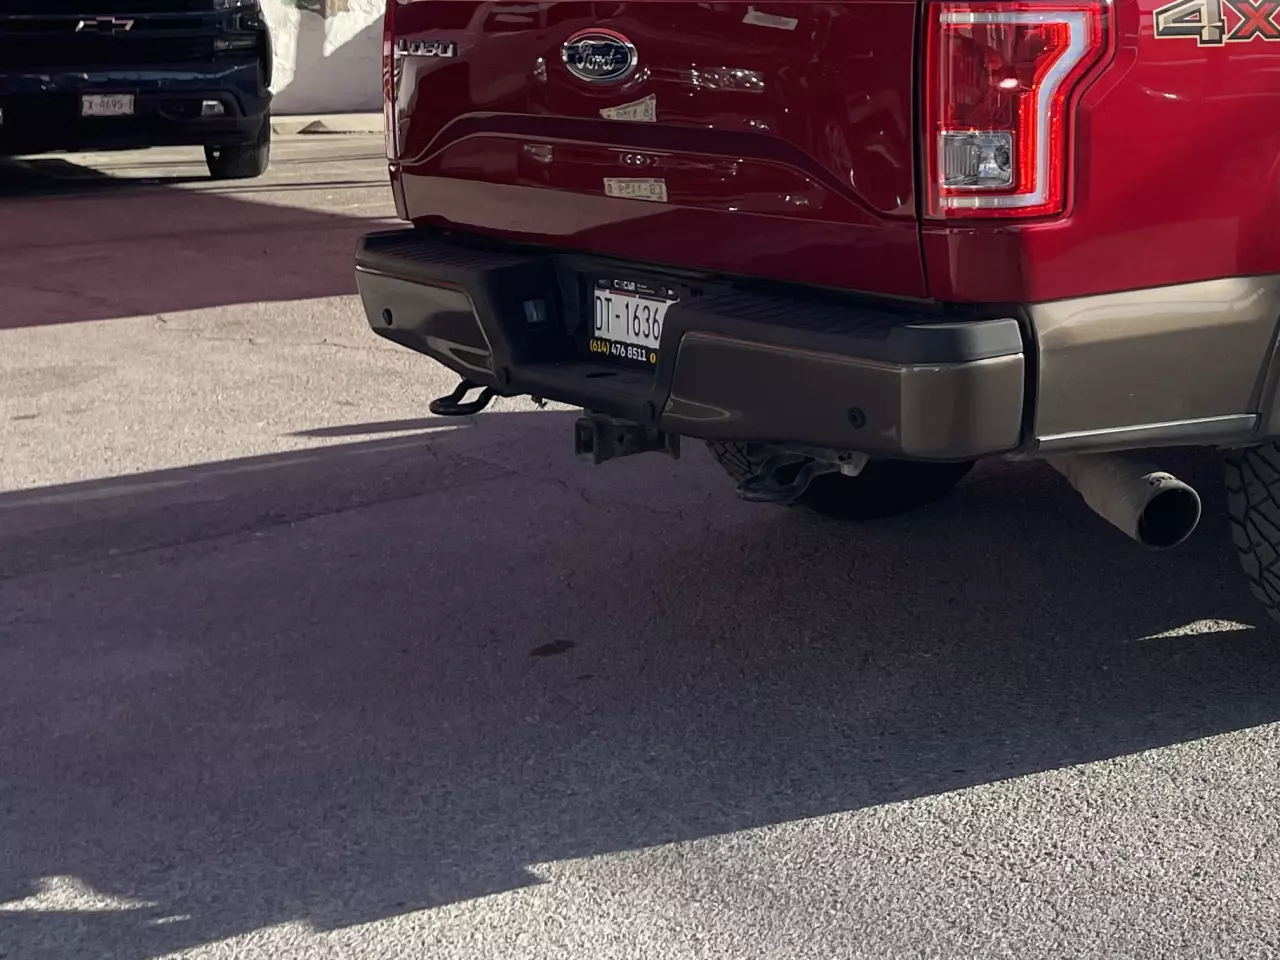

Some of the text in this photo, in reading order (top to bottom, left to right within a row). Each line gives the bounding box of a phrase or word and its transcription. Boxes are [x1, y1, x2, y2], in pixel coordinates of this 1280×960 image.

[595, 295, 661, 341] DT-1636
[590, 339, 610, 355] (614)
[611, 343, 626, 357] 476
[627, 346, 647, 361] 8511
